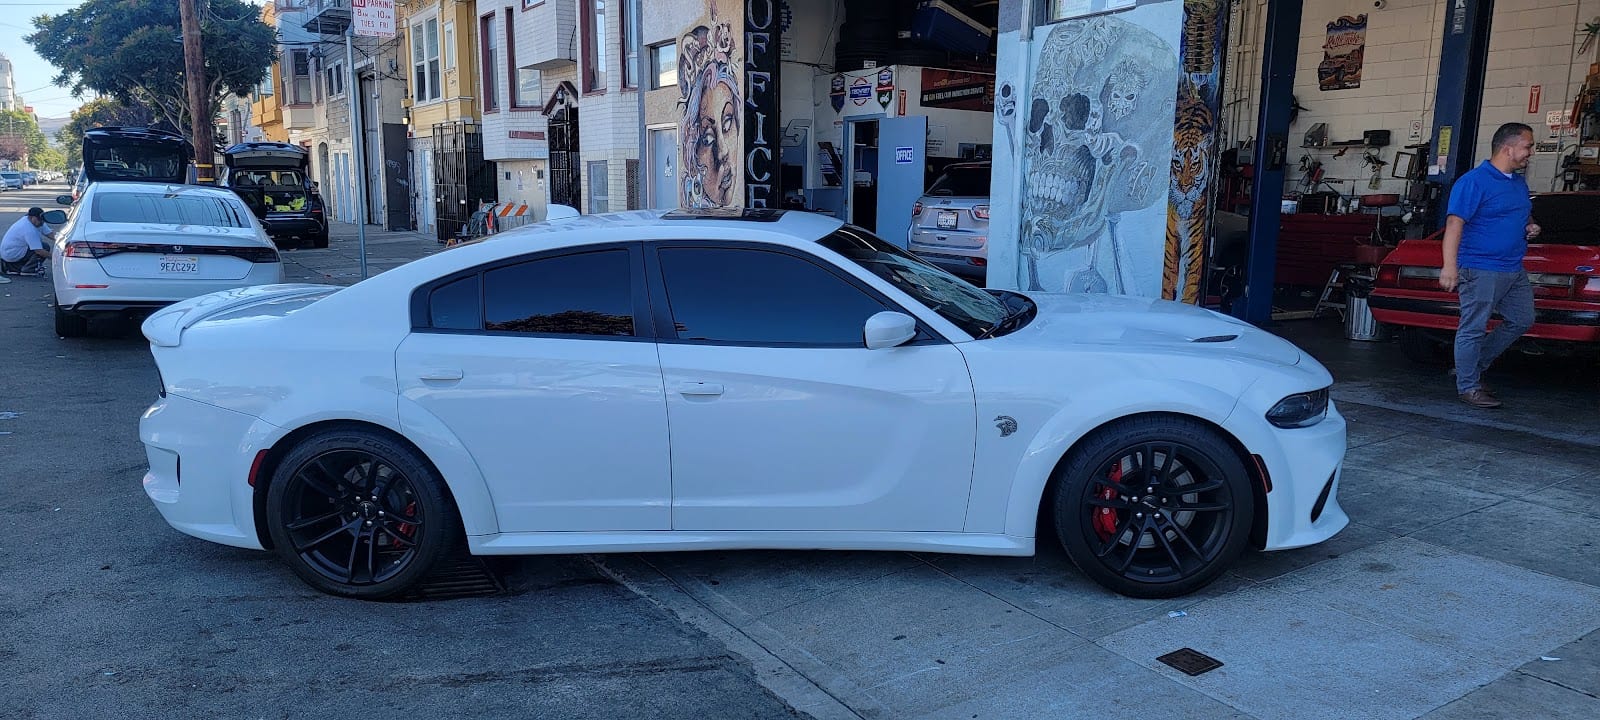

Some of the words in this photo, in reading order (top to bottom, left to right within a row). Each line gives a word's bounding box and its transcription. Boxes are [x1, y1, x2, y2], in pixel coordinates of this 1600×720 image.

[368, 0, 392, 9] PARKING
[896, 150, 912, 161] OFFICE
[161, 262, 196, 272] 9EZC292
